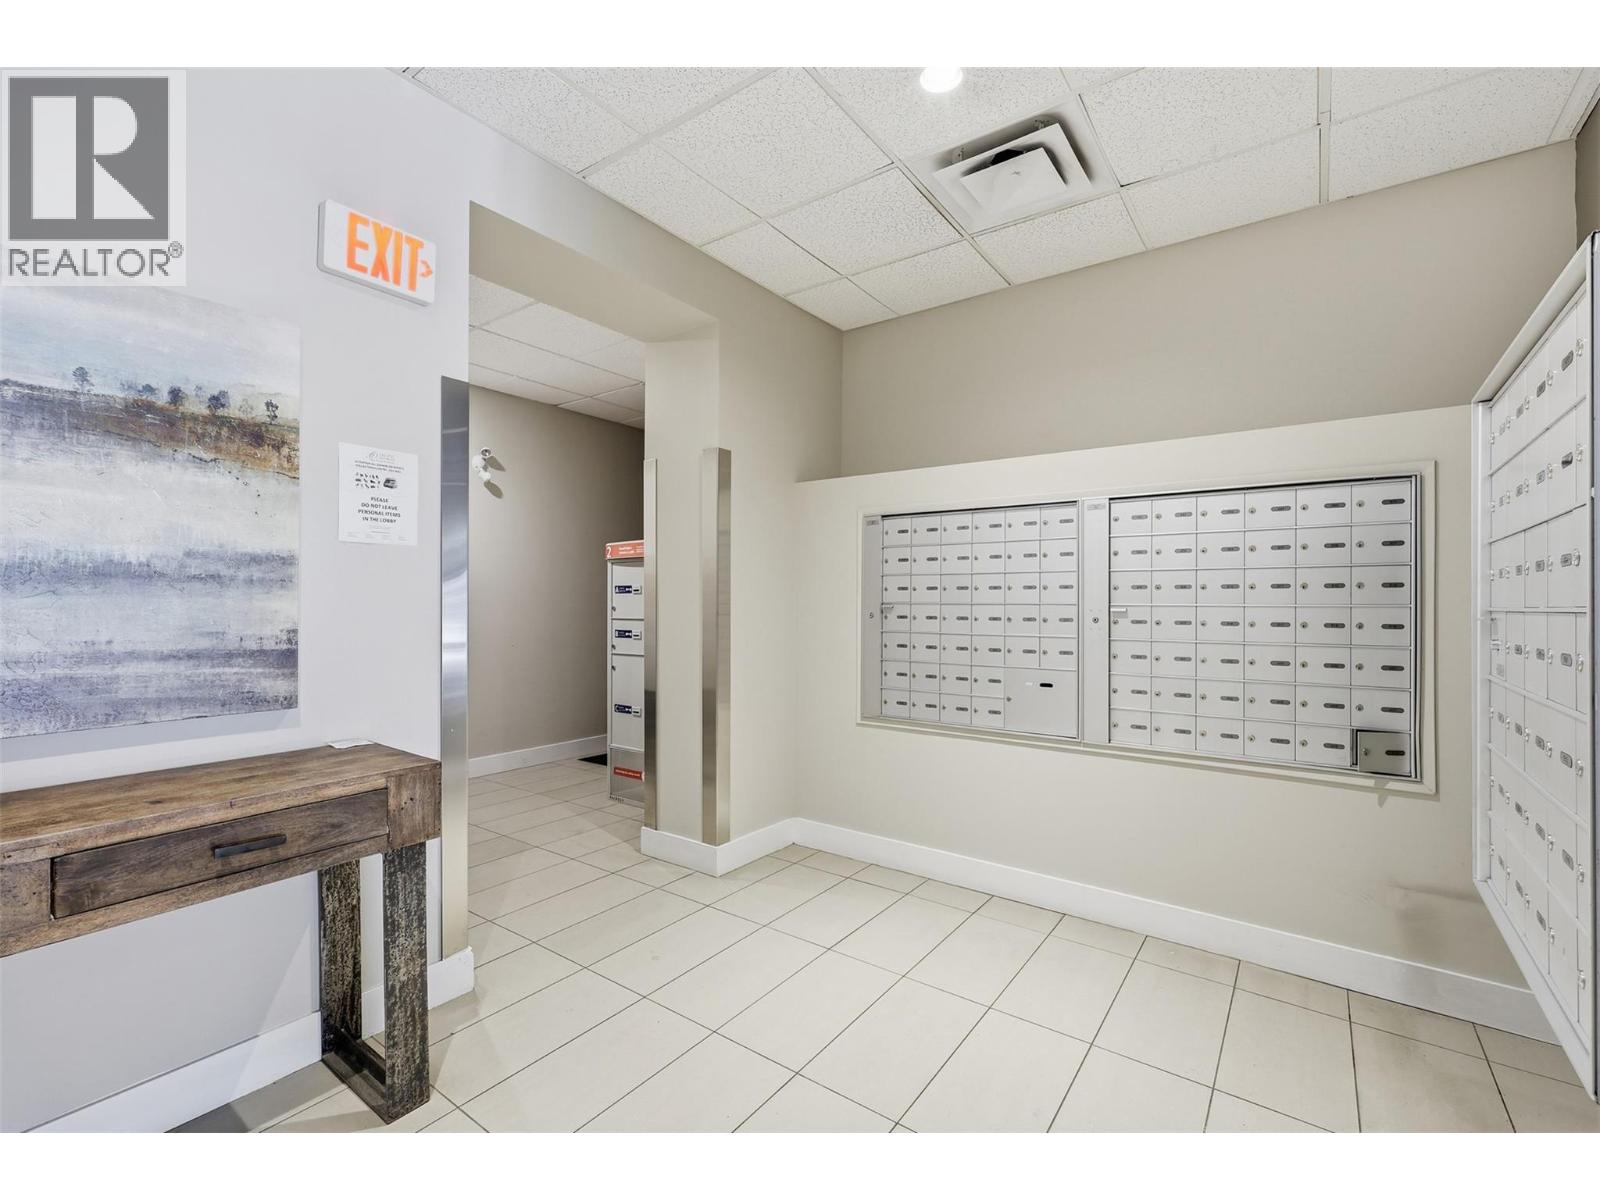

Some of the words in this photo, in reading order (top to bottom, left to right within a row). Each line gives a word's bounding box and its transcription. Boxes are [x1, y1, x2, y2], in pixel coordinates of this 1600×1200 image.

[346, 211, 424, 293] EXIT
[358, 508, 384, 516] PERSONAL
[606, 546, 612, 558] 2
